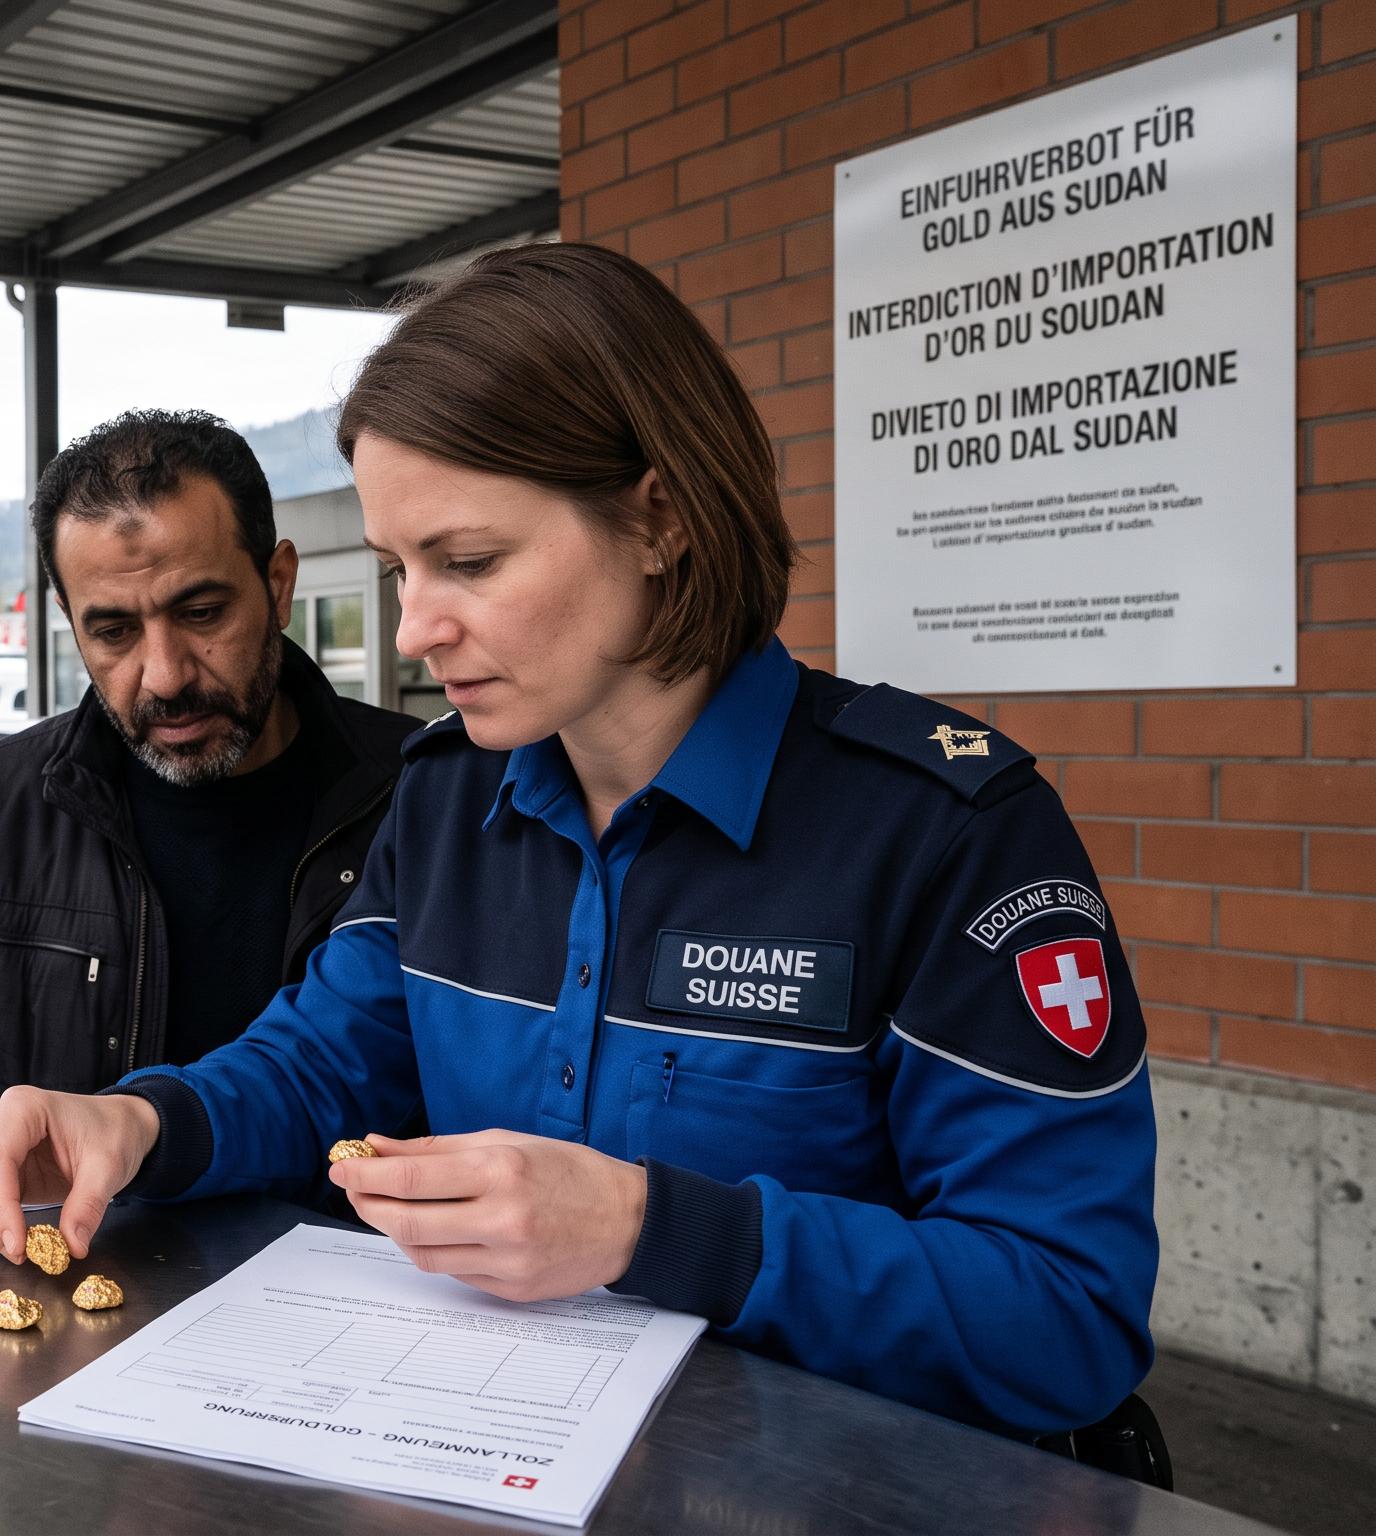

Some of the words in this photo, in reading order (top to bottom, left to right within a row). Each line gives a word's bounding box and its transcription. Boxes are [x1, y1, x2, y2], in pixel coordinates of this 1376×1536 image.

[900, 125, 1125, 219] EINFUHRVERBOT
[1133, 105, 1195, 153] FÜR
[923, 208, 990, 252] GOLD
[999, 190, 1055, 233] AUS
[1064, 159, 1168, 215] SUDAN
[849, 272, 1021, 339] INTERDICTION
[995, 312, 1032, 349] DU
[1041, 284, 1164, 339] SOUDAN
[872, 397, 966, 440] DIVIETO
[976, 391, 1002, 423] DI
[1012, 350, 1238, 419] IMPORTAZIONE
[914, 445, 938, 473] DI
[948, 433, 1000, 467] ORO
[1010, 424, 1064, 461] DAL
[1074, 406, 1178, 452] SUDAN
[978, 888, 1053, 940] DOUANE
[682, 942, 816, 978] DOUANE
[685, 979, 801, 1014] SUISSE
